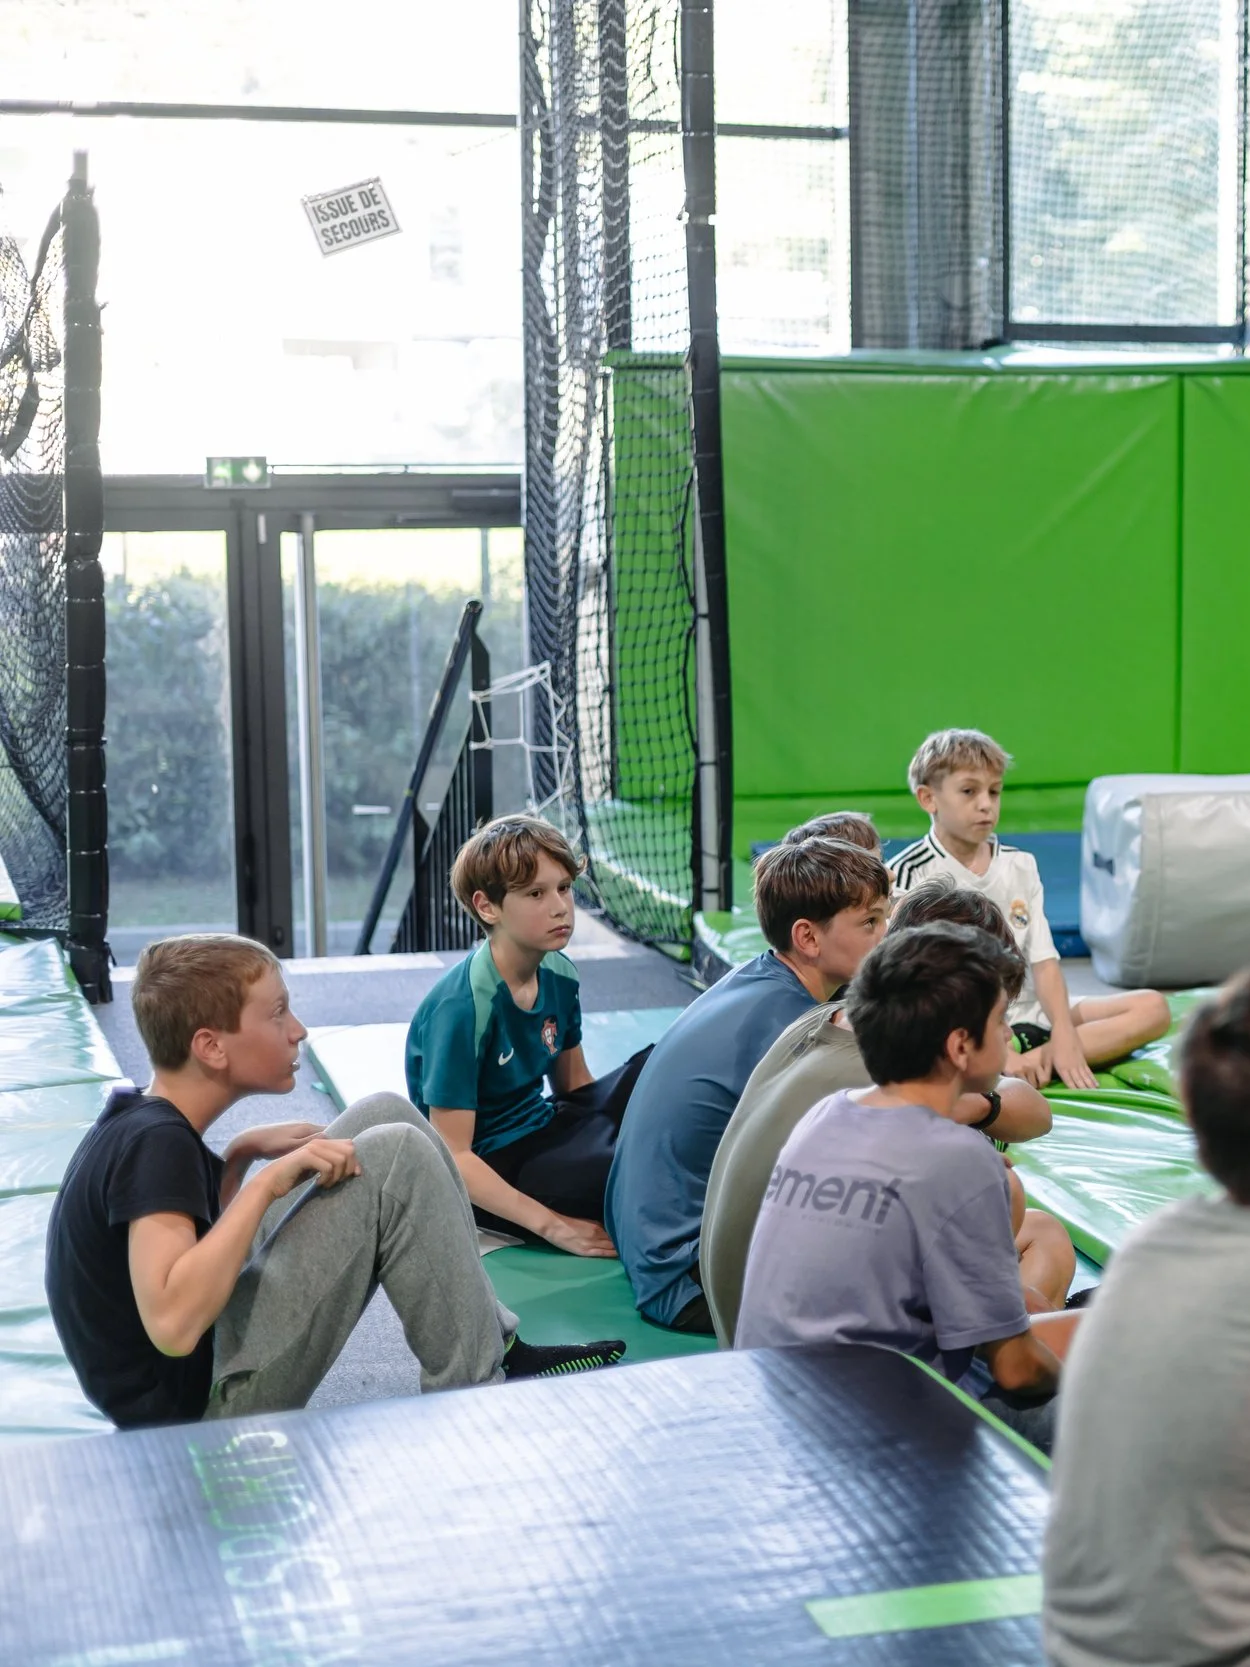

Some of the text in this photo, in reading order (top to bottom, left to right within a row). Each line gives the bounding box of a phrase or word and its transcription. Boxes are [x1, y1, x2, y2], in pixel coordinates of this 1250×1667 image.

[312, 187, 382, 224] ISSUE DE
[320, 209, 390, 246] SECOURS
